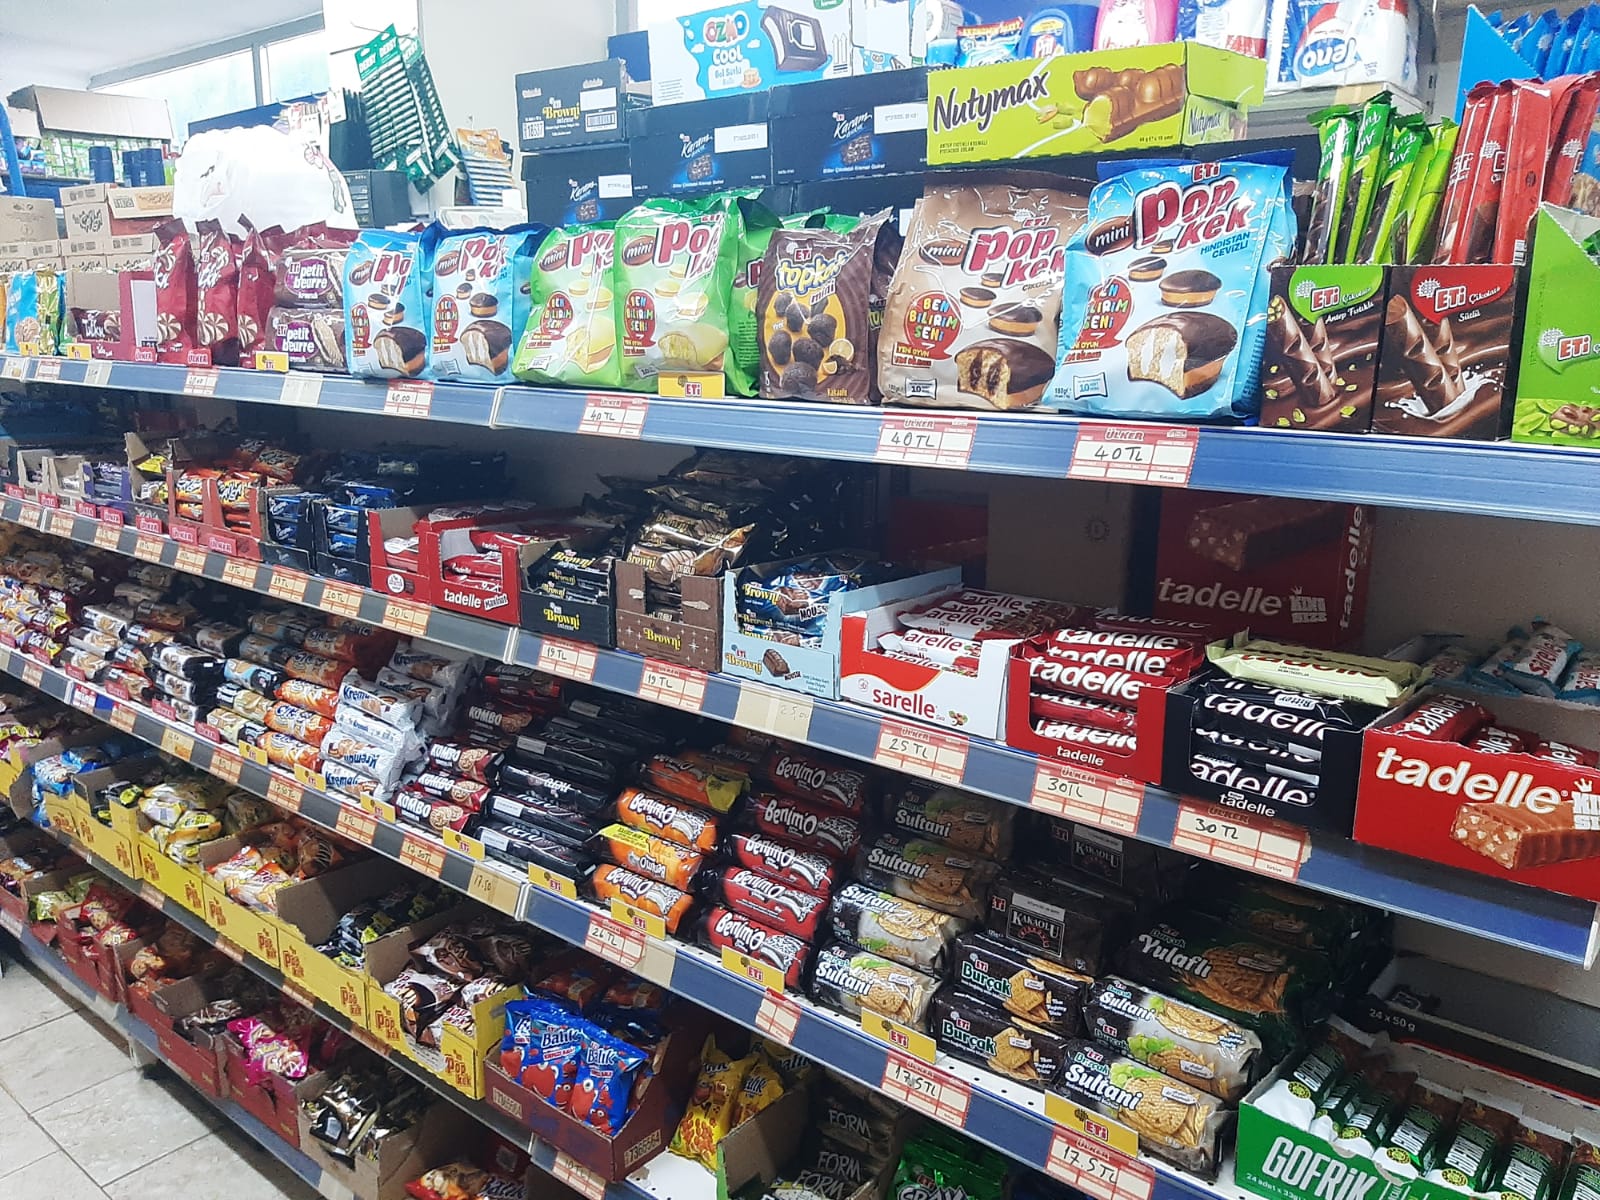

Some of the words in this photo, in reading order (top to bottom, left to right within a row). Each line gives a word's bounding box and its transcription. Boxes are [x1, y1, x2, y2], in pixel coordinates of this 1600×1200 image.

[542, 101, 580, 120] Browni
[933, 71, 1049, 132] Nutymax
[1095, 221, 1130, 249] mini
[543, 247, 567, 265] mini
[625, 241, 654, 260] mini
[928, 243, 964, 258] mini
[300, 264, 325, 280] petit
[438, 257, 460, 273] mini
[293, 278, 328, 289] beurre
[923, 298, 950, 312] BEN
[1458, 309, 1481, 323] Sütlü
[1325, 312, 1346, 325] Antep
[286, 326, 311, 341] petit
[282, 340, 315, 353] beurre
[911, 384, 921, 393] 10
[904, 417, 935, 430] ÜLKER
[1104, 427, 1145, 442] ÜLKER
[1339, 504, 1363, 631] tadelle
[444, 588, 482, 609] tadelle
[1159, 576, 1283, 616] tadelle
[544, 608, 580, 630] Browni
[642, 626, 681, 650] Browni
[725, 652, 762, 675] Browni
[1030, 654, 1140, 700] tadelle
[470, 705, 502, 726] KOMBO
[873, 687, 936, 720] sarelle
[430, 743, 461, 763] KOMBO
[1056, 745, 1104, 766] tadelle
[417, 771, 454, 791] KOMBO
[1375, 746, 1561, 814] tadelle
[395, 792, 432, 818] KOMBO
[1219, 792, 1276, 817] tadelle
[895, 809, 952, 839] Sultani
[867, 847, 930, 880] Sultani
[1075, 840, 1120, 869] KAKAOLU
[841, 884, 902, 914] Sultani
[1011, 910, 1059, 938] KAKAOLU
[1138, 933, 1213, 979] Yulaflı
[815, 961, 875, 997] Sultani
[961, 960, 1012, 998] Burçak
[1100, 990, 1156, 1022] Sultani
[1369, 1007, 1382, 1020] 24
[1392, 1016, 1407, 1030] 50
[1407, 1022, 1416, 1033] g
[942, 1019, 996, 1056] Burçak
[1074, 1052, 1110, 1075] Burçak
[1064, 1064, 1144, 1111] Sultani
[828, 1109, 872, 1141] FORM
[818, 1151, 861, 1183] FORM
[799, 1168, 846, 1199] FORM
